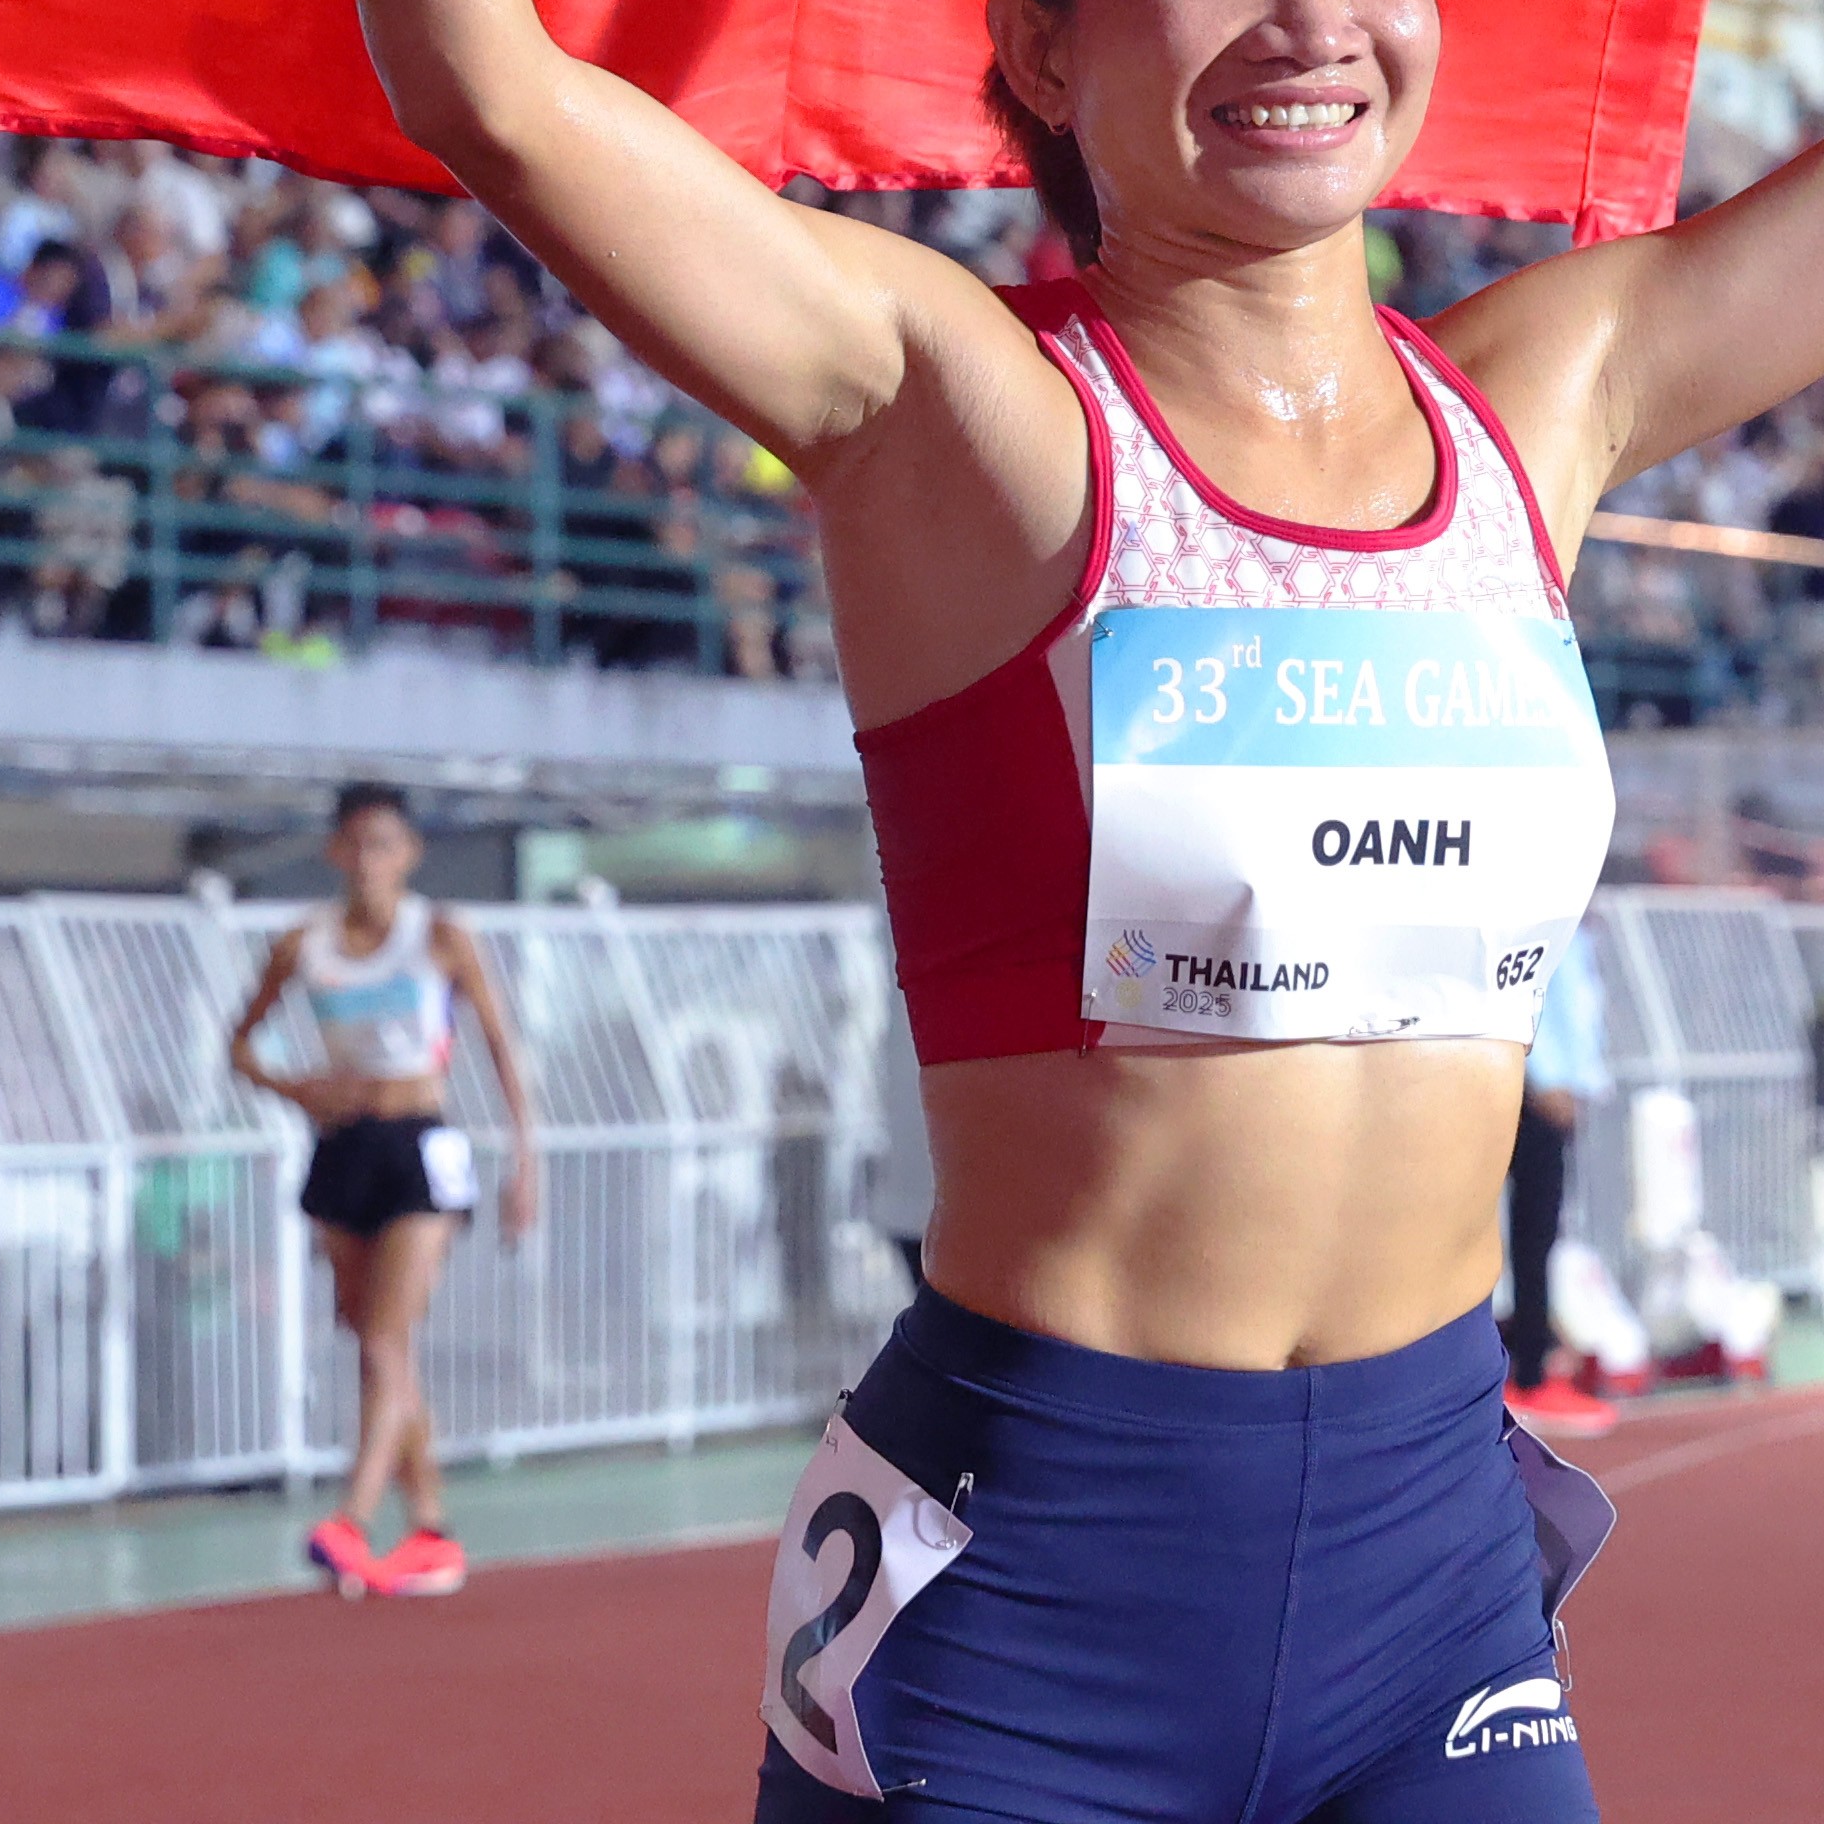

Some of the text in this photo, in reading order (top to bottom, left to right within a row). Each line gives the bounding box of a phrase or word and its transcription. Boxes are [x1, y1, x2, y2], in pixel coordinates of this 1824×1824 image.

[1276, 658, 1387, 726] SEA
[1405, 658, 1578, 728] GAME
[1311, 819, 1472, 868] OANH
[1165, 953, 1330, 992] THAILAND
[1496, 945, 1545, 991] 652
[1162, 986, 1232, 1018] 2025
[781, 1490, 883, 1756] 2
[1445, 1710, 1578, 1759] LI-NING
